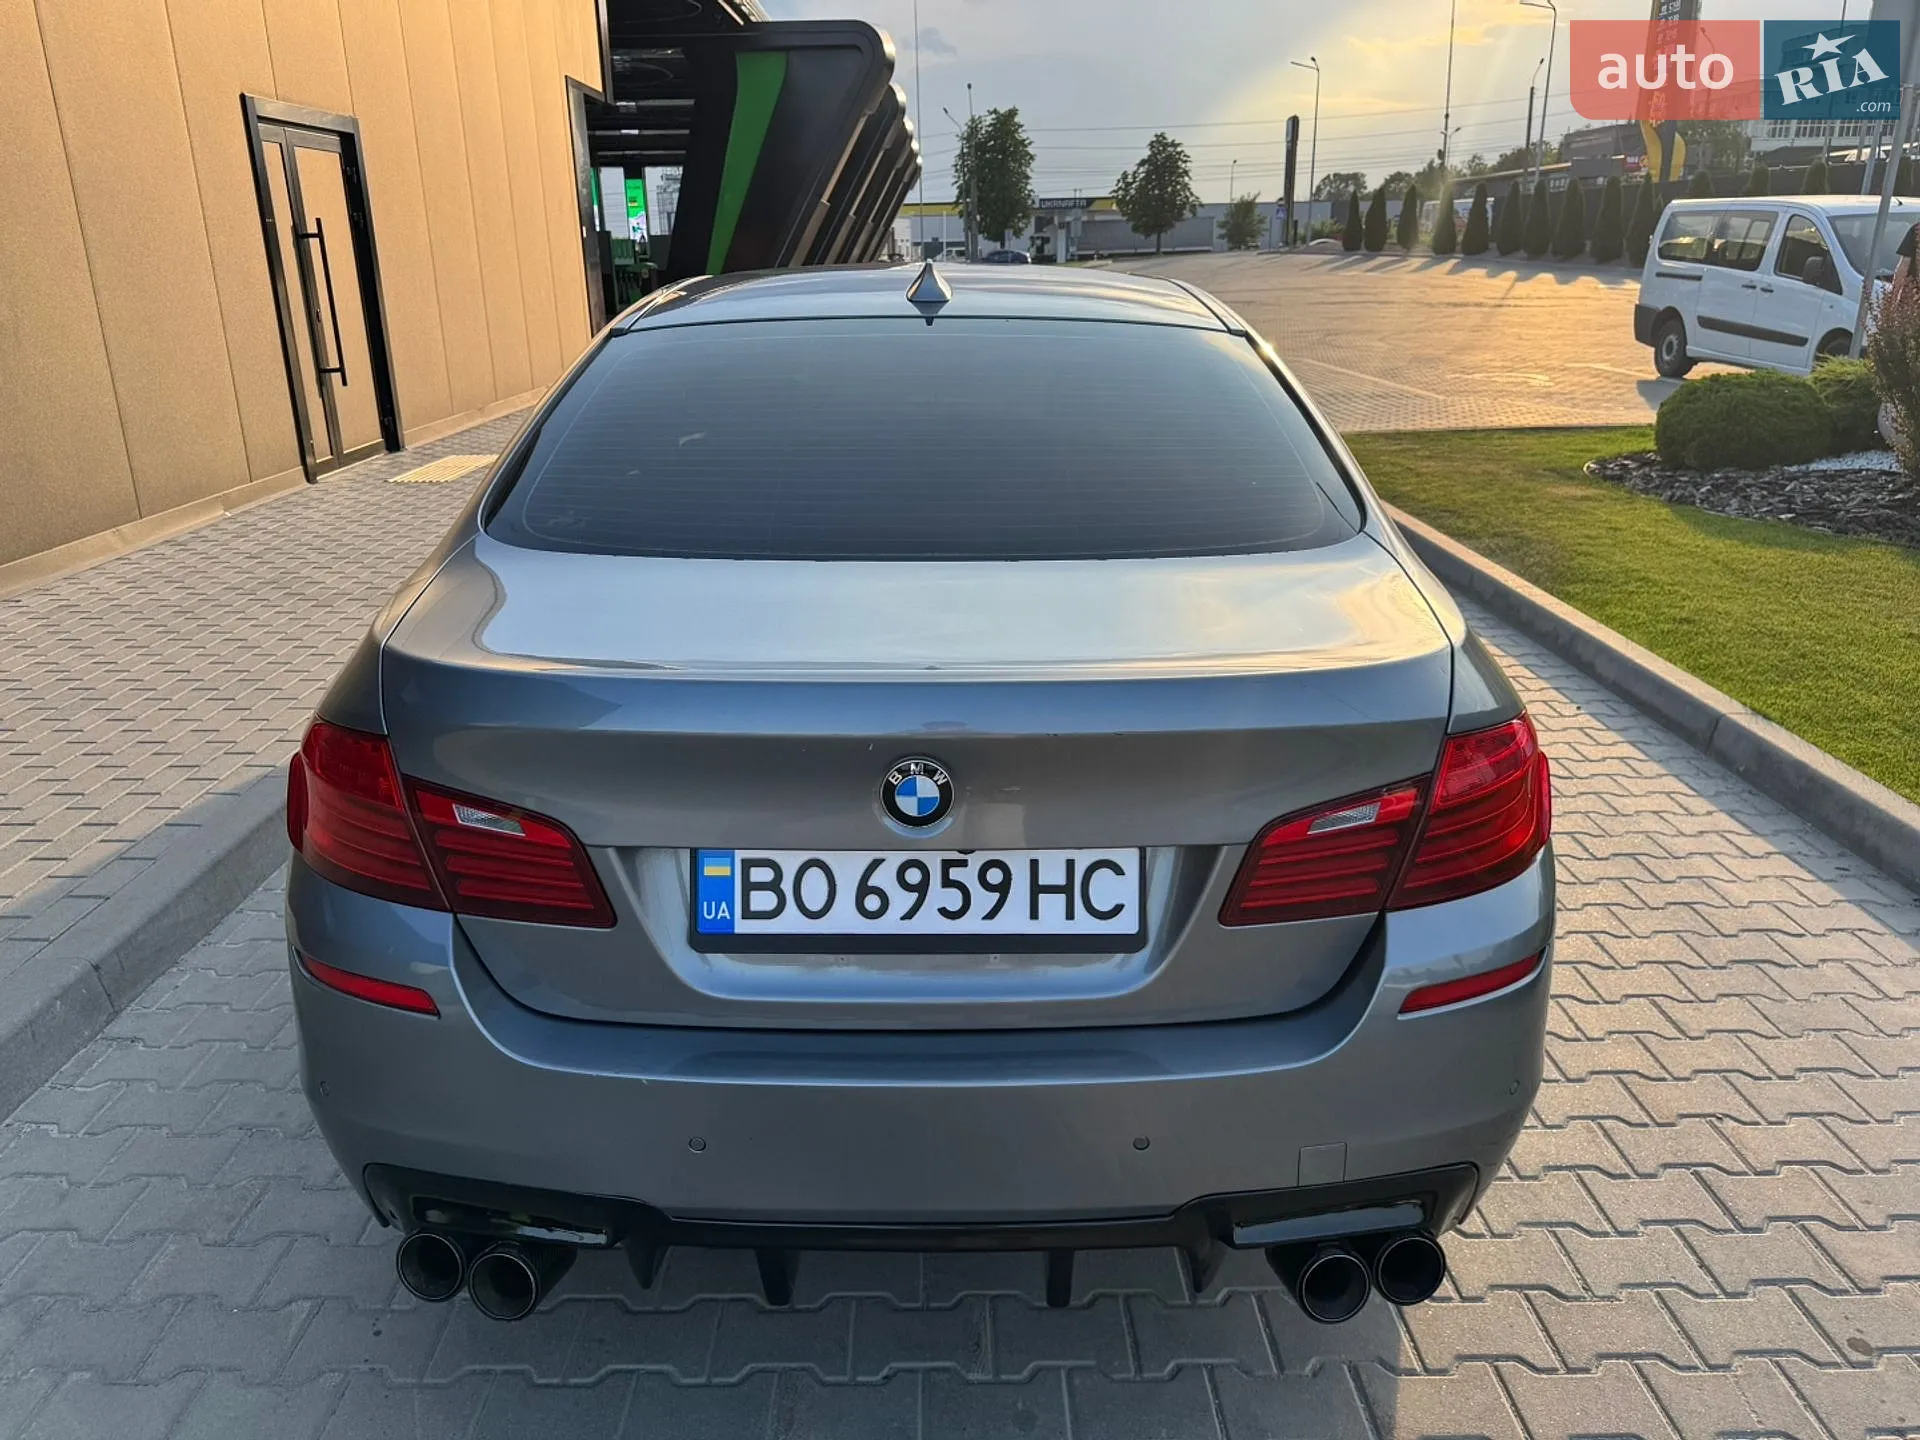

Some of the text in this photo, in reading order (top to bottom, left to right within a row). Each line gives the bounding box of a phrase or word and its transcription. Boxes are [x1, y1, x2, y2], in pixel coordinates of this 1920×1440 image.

[888, 762, 948, 786] BMW
[740, 858, 1126, 920] BO 6959 HC
[703, 901, 730, 920] UA
